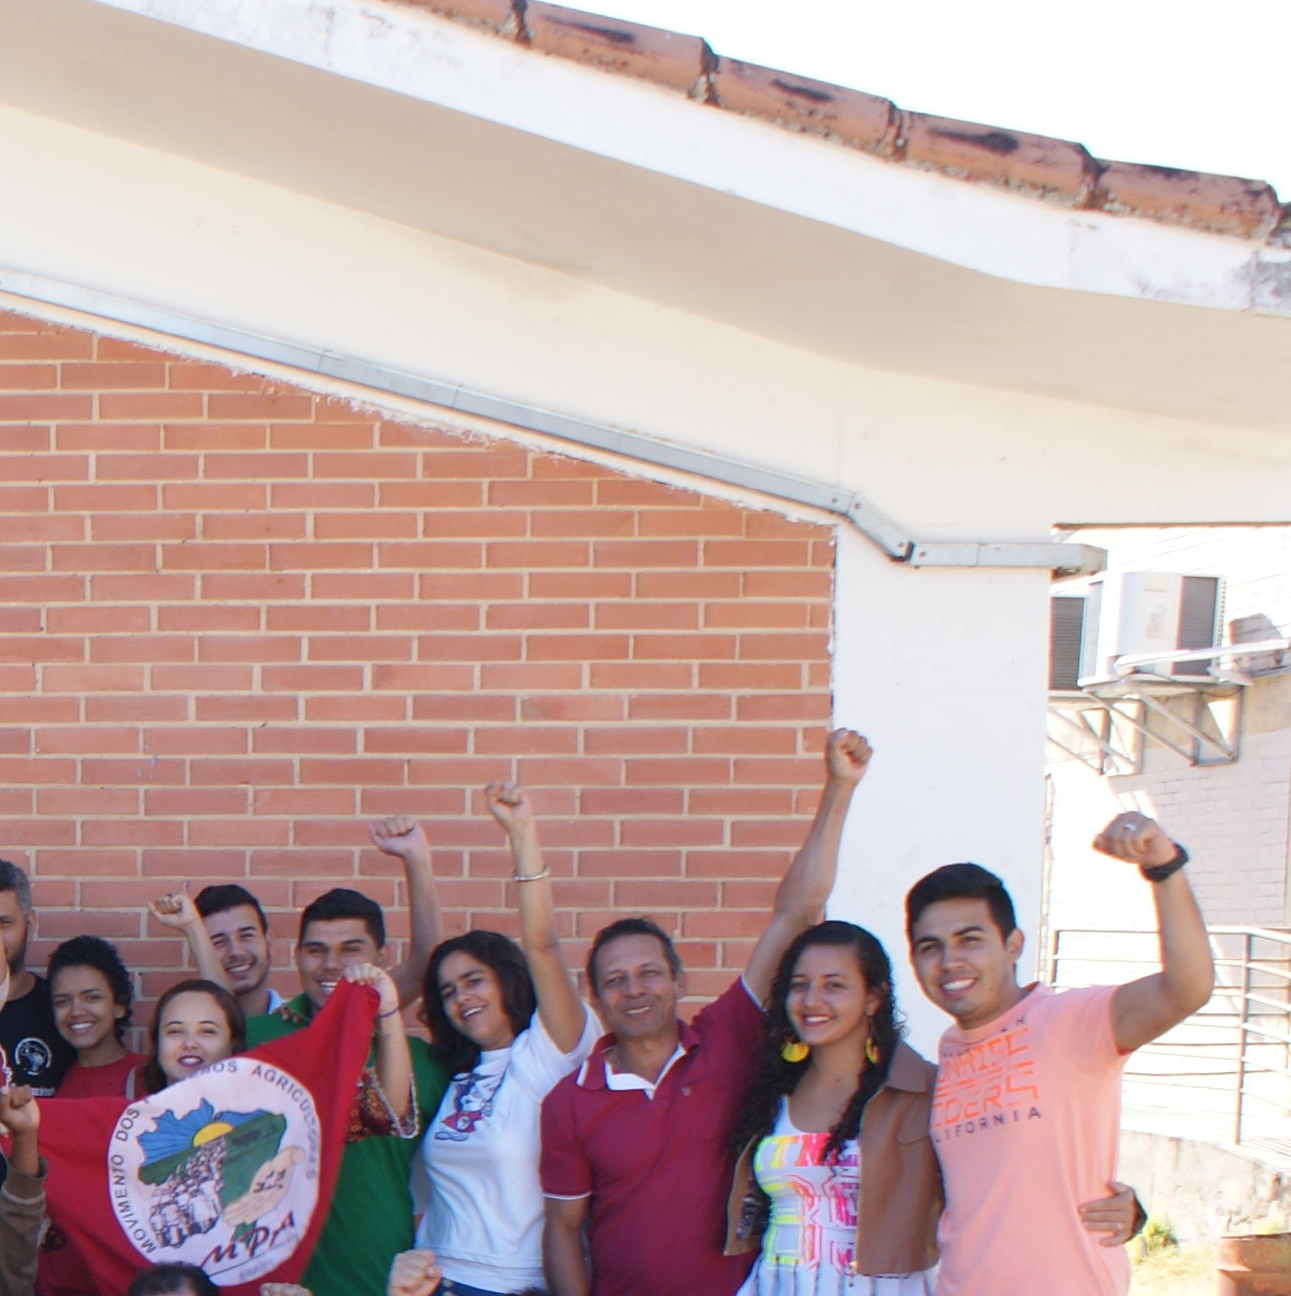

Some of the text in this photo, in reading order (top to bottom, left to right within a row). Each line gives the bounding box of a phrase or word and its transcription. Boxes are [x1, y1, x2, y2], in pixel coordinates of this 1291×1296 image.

[110, 1107, 158, 1254] MOVIMENTO DOS
[200, 1210, 295, 1268] MPA
